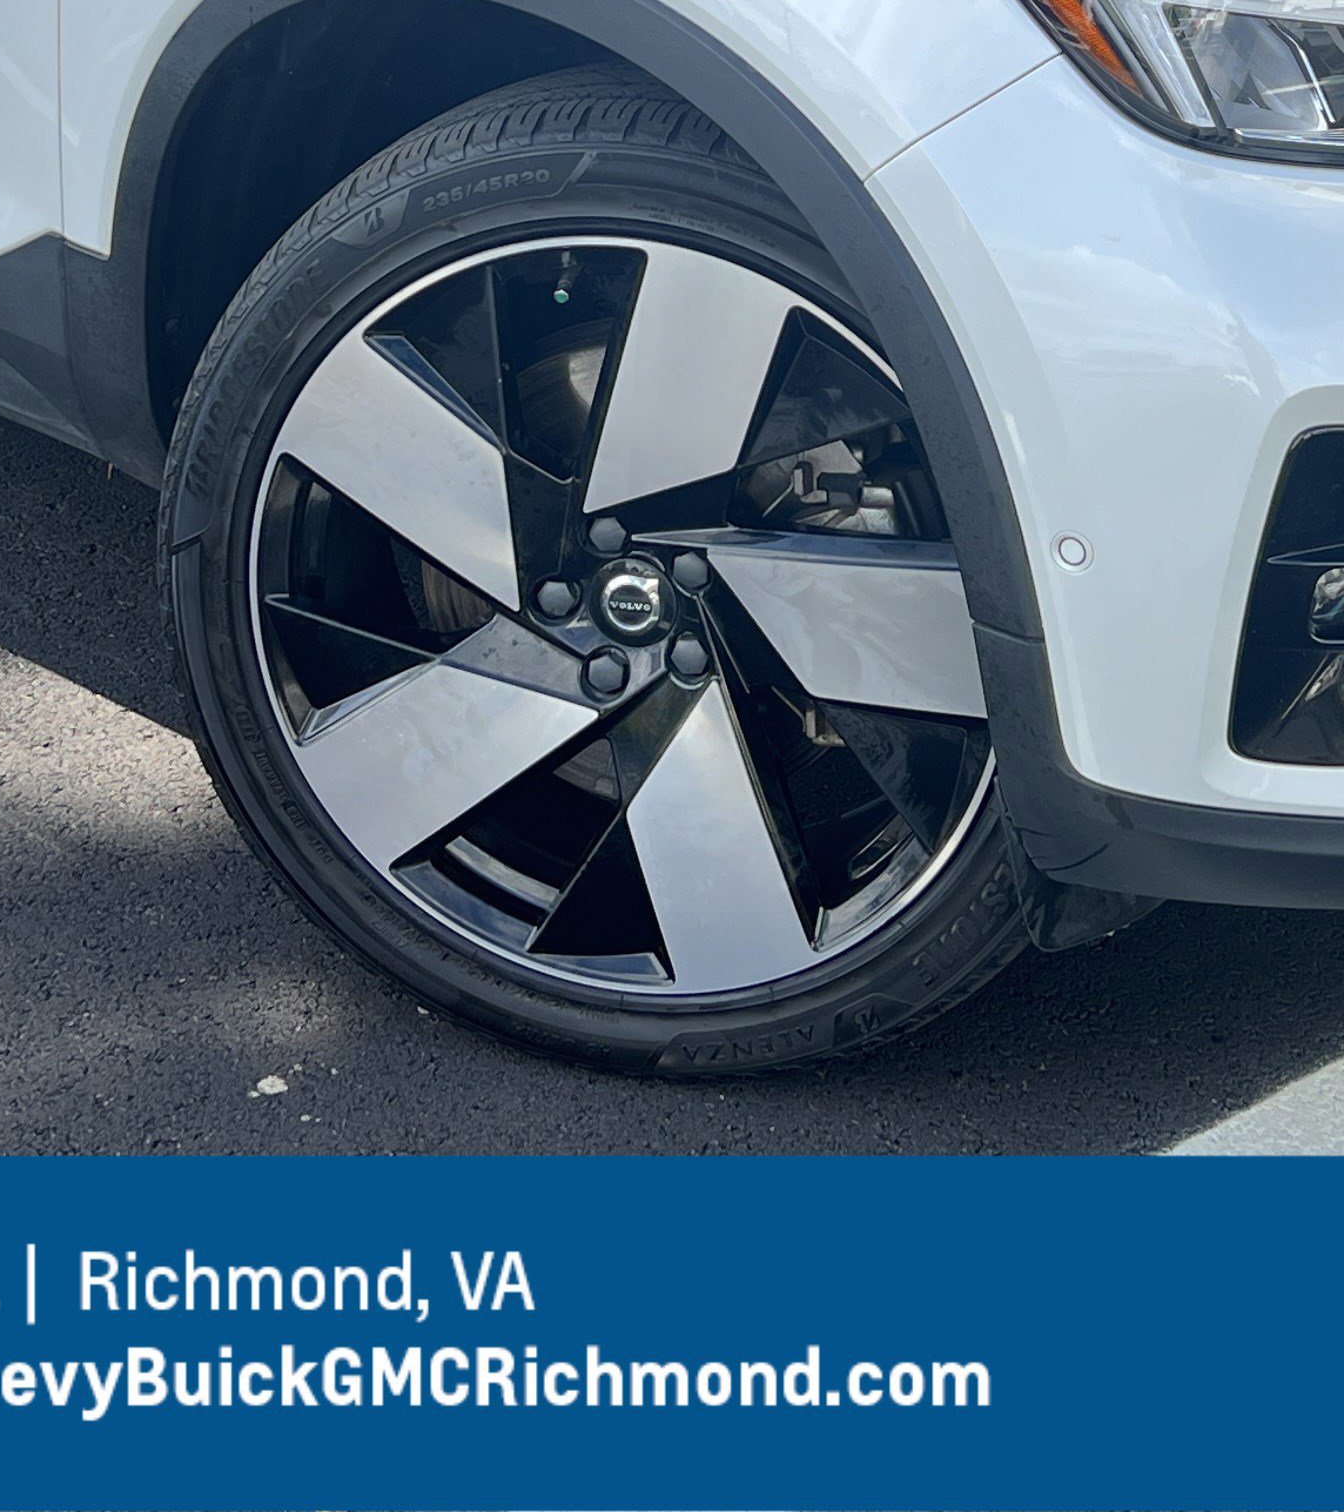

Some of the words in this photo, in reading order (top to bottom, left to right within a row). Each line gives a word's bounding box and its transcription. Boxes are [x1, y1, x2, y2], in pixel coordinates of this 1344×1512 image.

[423, 168, 552, 213] 235/45R20
[608, 599, 652, 612] VOLVO
[681, 1023, 814, 1063] ALENZA
